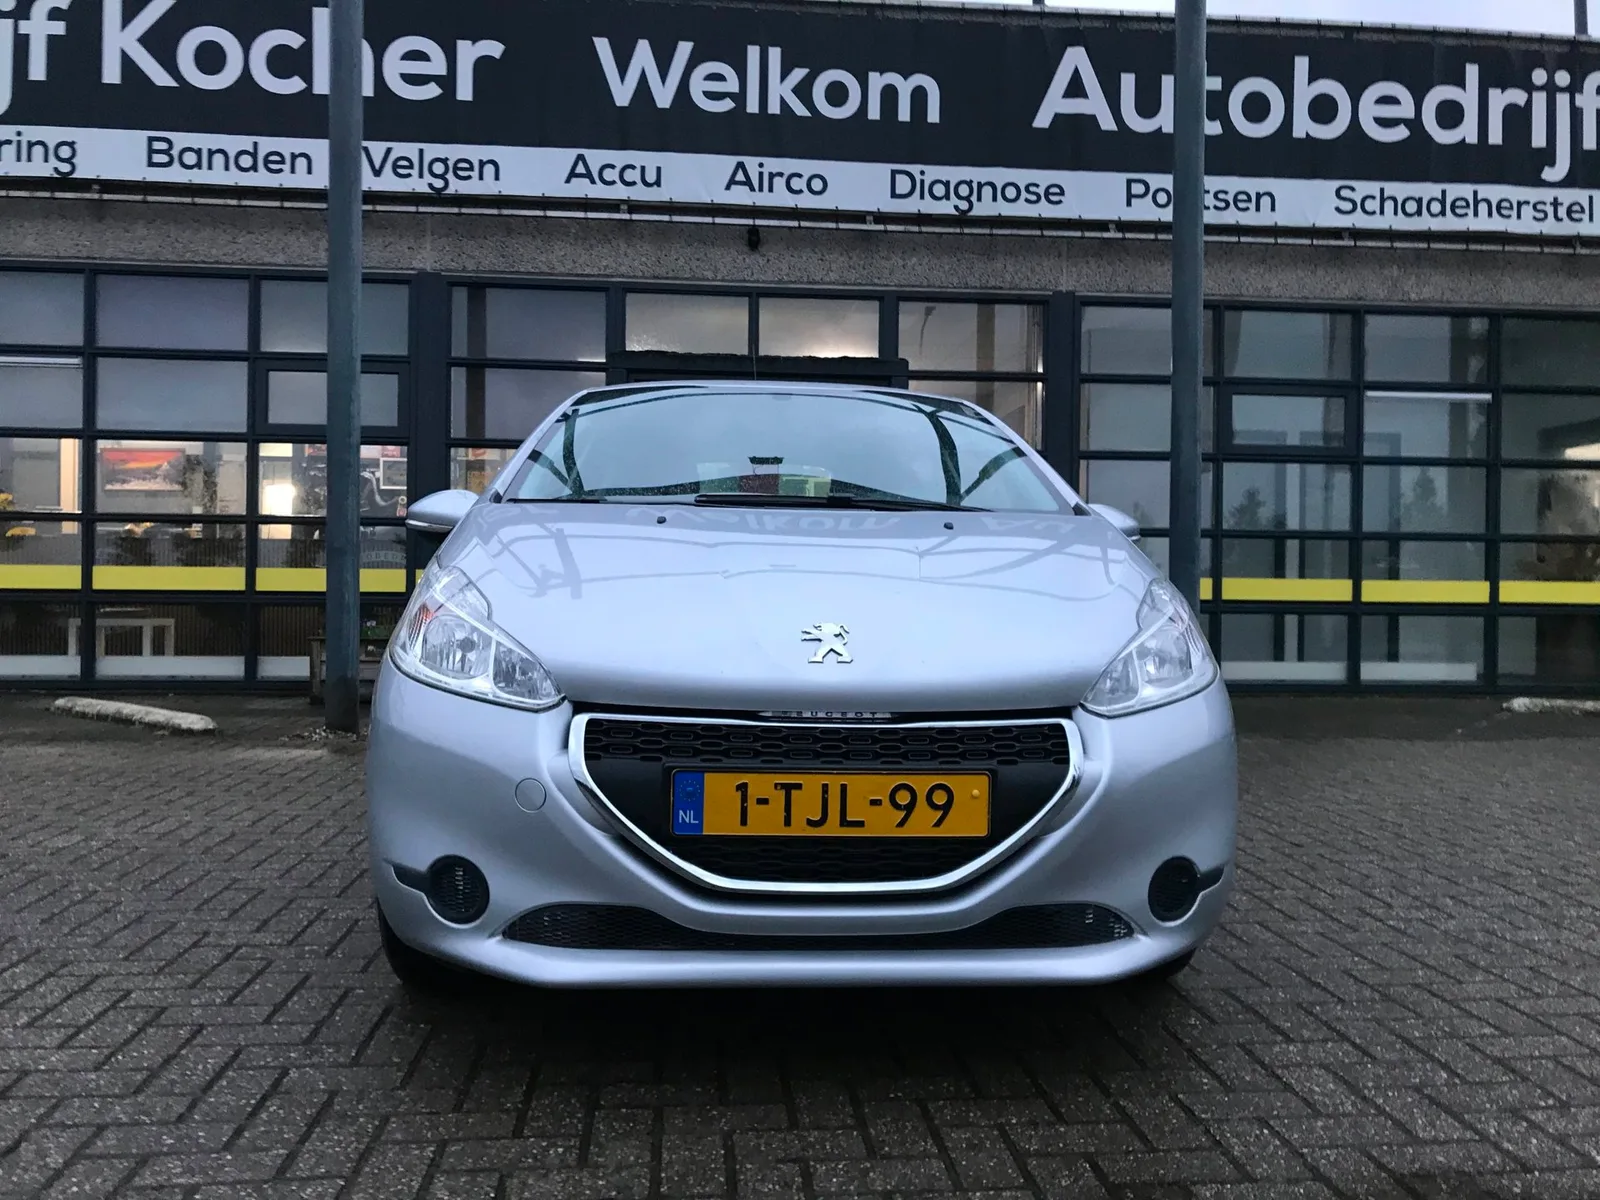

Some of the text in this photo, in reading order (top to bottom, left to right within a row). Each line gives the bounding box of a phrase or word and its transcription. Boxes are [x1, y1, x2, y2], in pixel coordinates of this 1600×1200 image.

[102, 0, 506, 102] Kocher
[592, 37, 940, 123] Welkom
[146, 136, 313, 176] Banden
[362, 145, 500, 193] Velgen
[564, 153, 662, 188] Accu
[724, 161, 828, 196] Airco
[889, 169, 1066, 214] Diagnose
[1334, 184, 1594, 223] Schadeherstel
[678, 809, 699, 824] NL
[735, 781, 955, 829] 1-TJL-99
